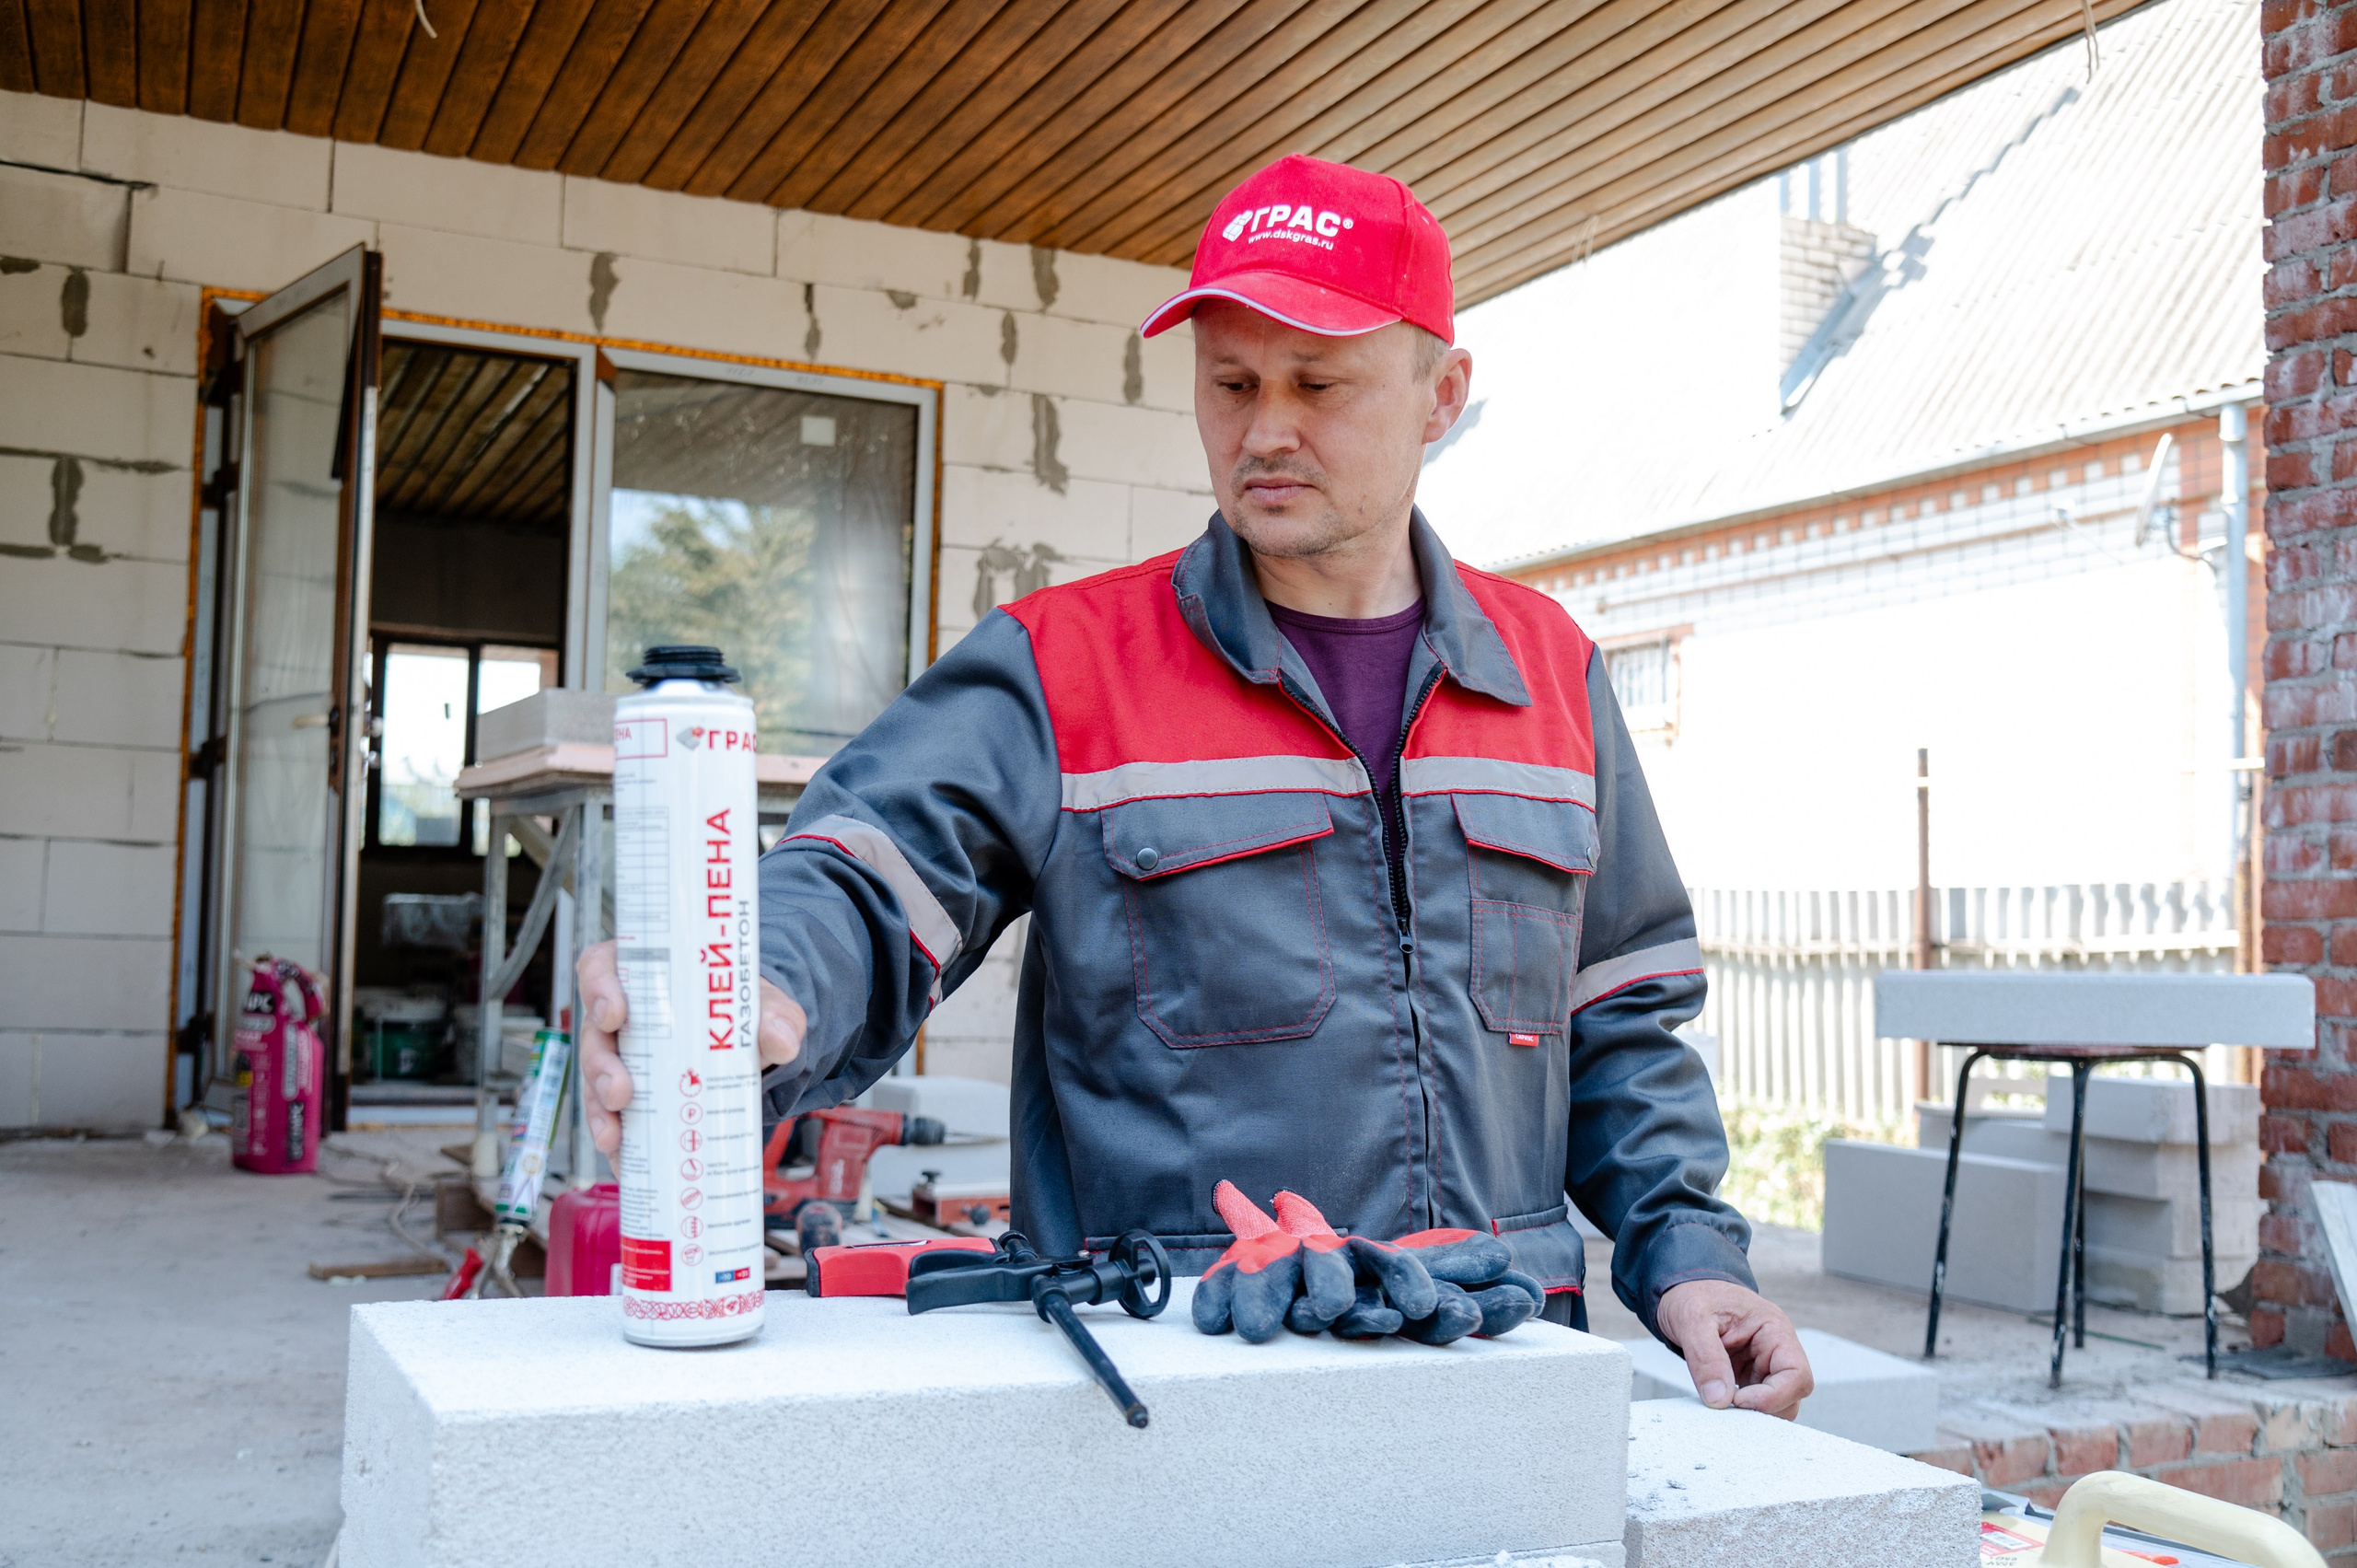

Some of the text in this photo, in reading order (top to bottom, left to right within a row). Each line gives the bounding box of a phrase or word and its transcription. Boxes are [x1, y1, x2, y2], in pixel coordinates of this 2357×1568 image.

[1248, 228, 1334, 251] www.dskgras.ru
[700, 807, 735, 1051] КЛЕЙ-ПЕНА
[737, 899, 752, 1049] ГАЗОБЕТОН
